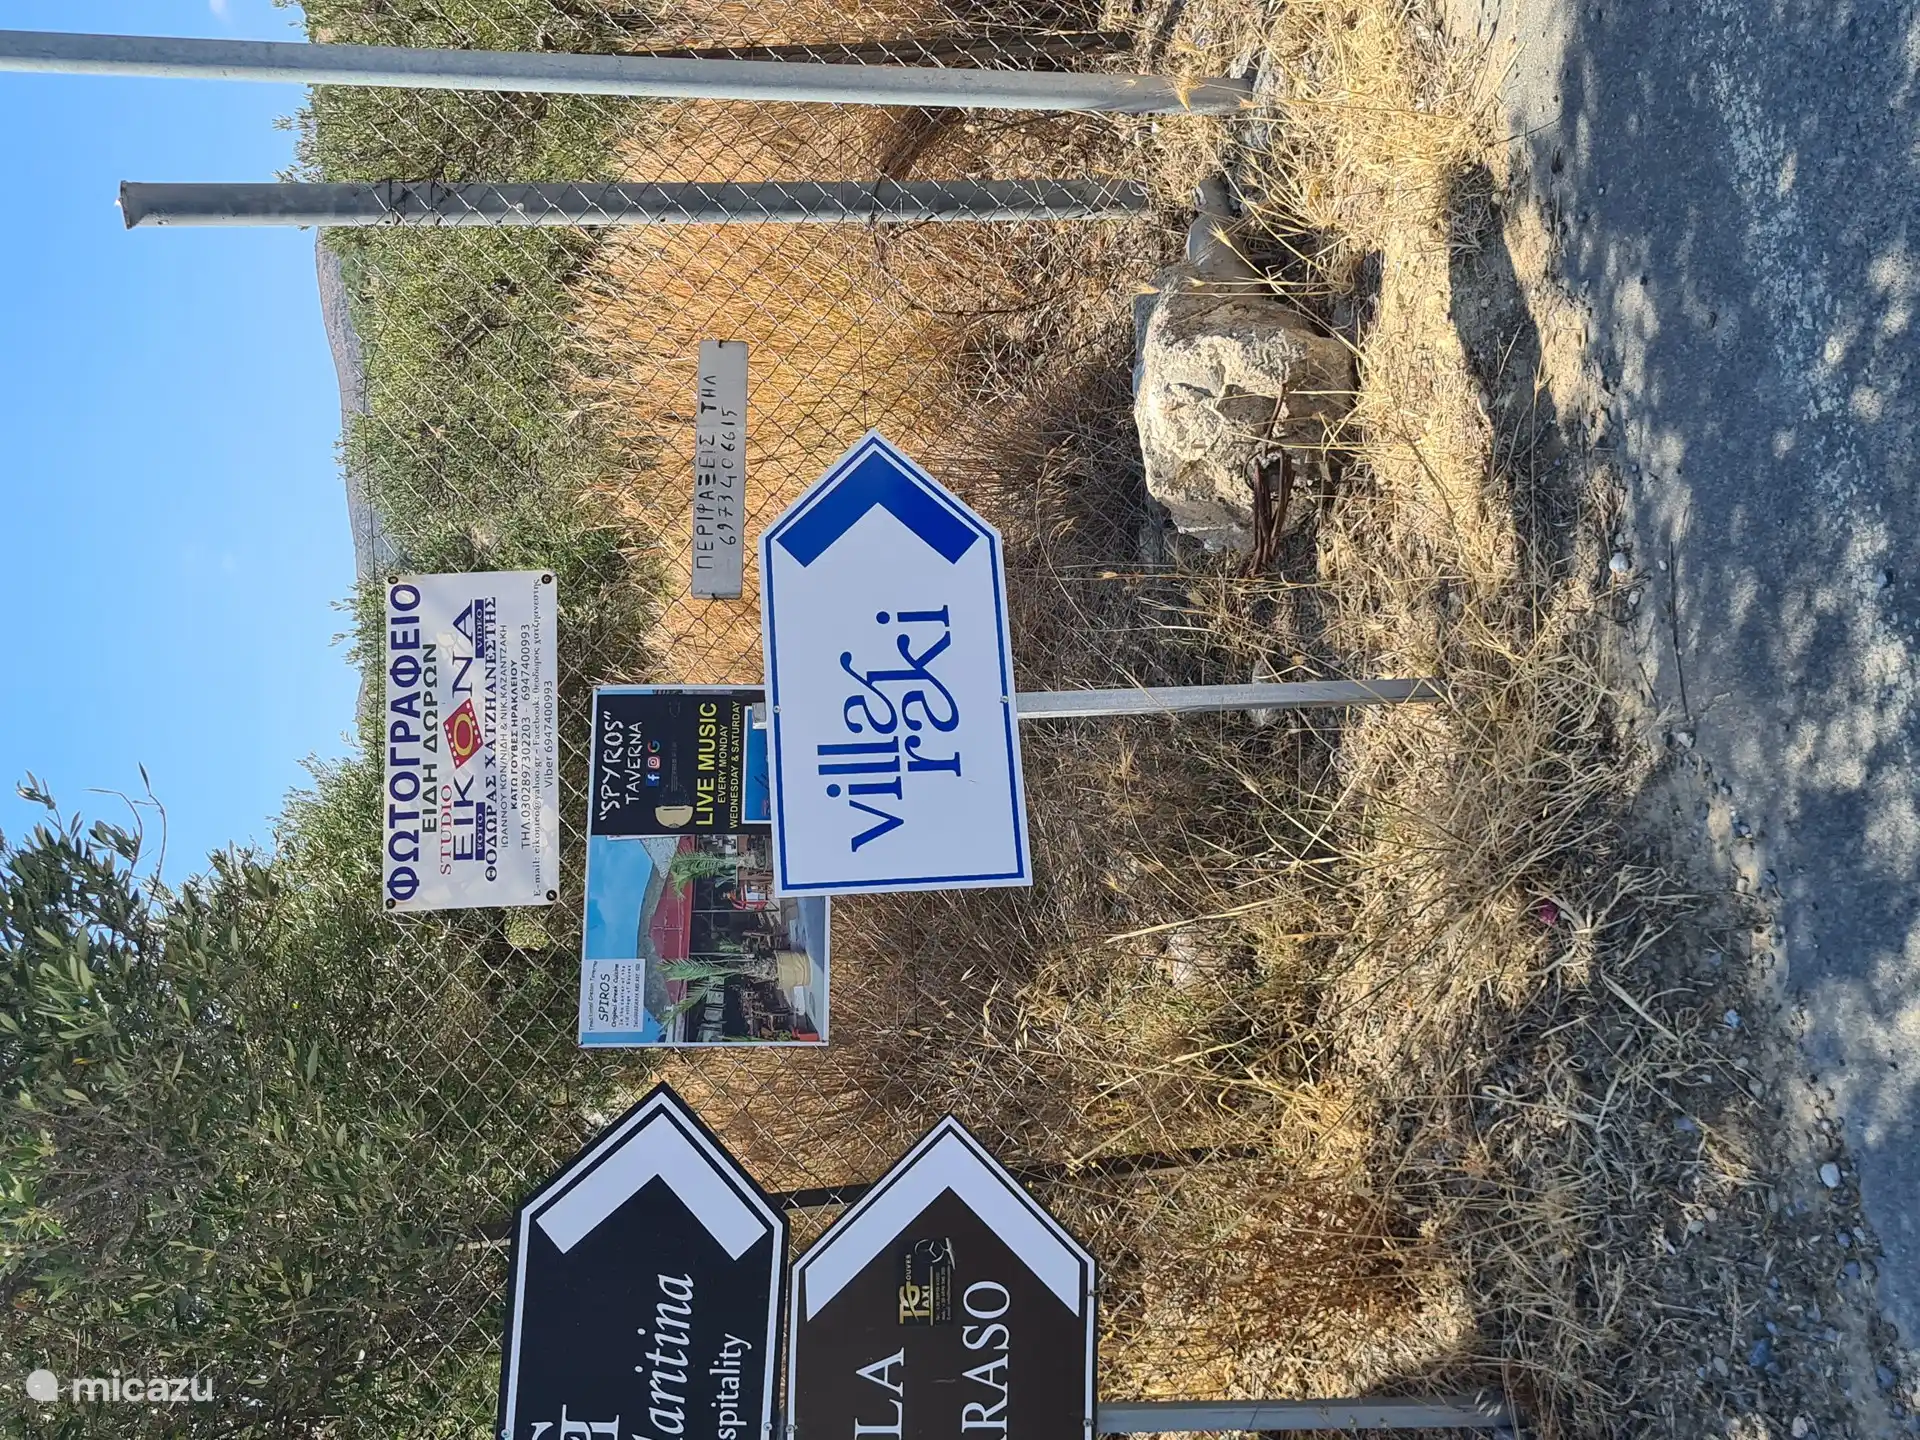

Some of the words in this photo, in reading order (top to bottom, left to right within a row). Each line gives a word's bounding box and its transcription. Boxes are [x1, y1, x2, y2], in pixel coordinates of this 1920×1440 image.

[700, 375, 717, 414] ΤΗΛ
[696, 434, 716, 569] ΠΕΡΙΦΑΞΕΙΣ
[484, 597, 497, 768] ΧΑΤΖΗΑΝΕΣΤΗΣ
[521, 624, 530, 700] 6947400993
[866, 605, 961, 777] raki
[423, 644, 437, 753] ΔΩΡΩΝ
[544, 681, 553, 752] 6947400993
[731, 701, 740, 753] SATURDAY
[387, 584, 421, 901] ΦΩΤΟΓΡΑΦΕΙΟ
[500, 734, 508, 789] ΚΩΝ/ΝΙΔΗ
[624, 722, 642, 804] TAVERNA
[698, 703, 717, 770] MUSIC
[719, 724, 728, 767] MONDAY
[817, 651, 904, 852] villa
[422, 764, 437, 832] ΕΙΔΗ
[544, 756, 553, 788] Viber
[696, 778, 714, 825] LIVE
[718, 770, 727, 803] EVERY
[730, 765, 739, 828] WEDNESDAY
[440, 785, 452, 875] STUDIO
[485, 775, 497, 882] ΘΟΔΩΡΑΣ
[532, 857, 540, 896] E-mail:
[598, 974, 610, 1022] SPIROS
[961, 1280, 1010, 1440] RASO
